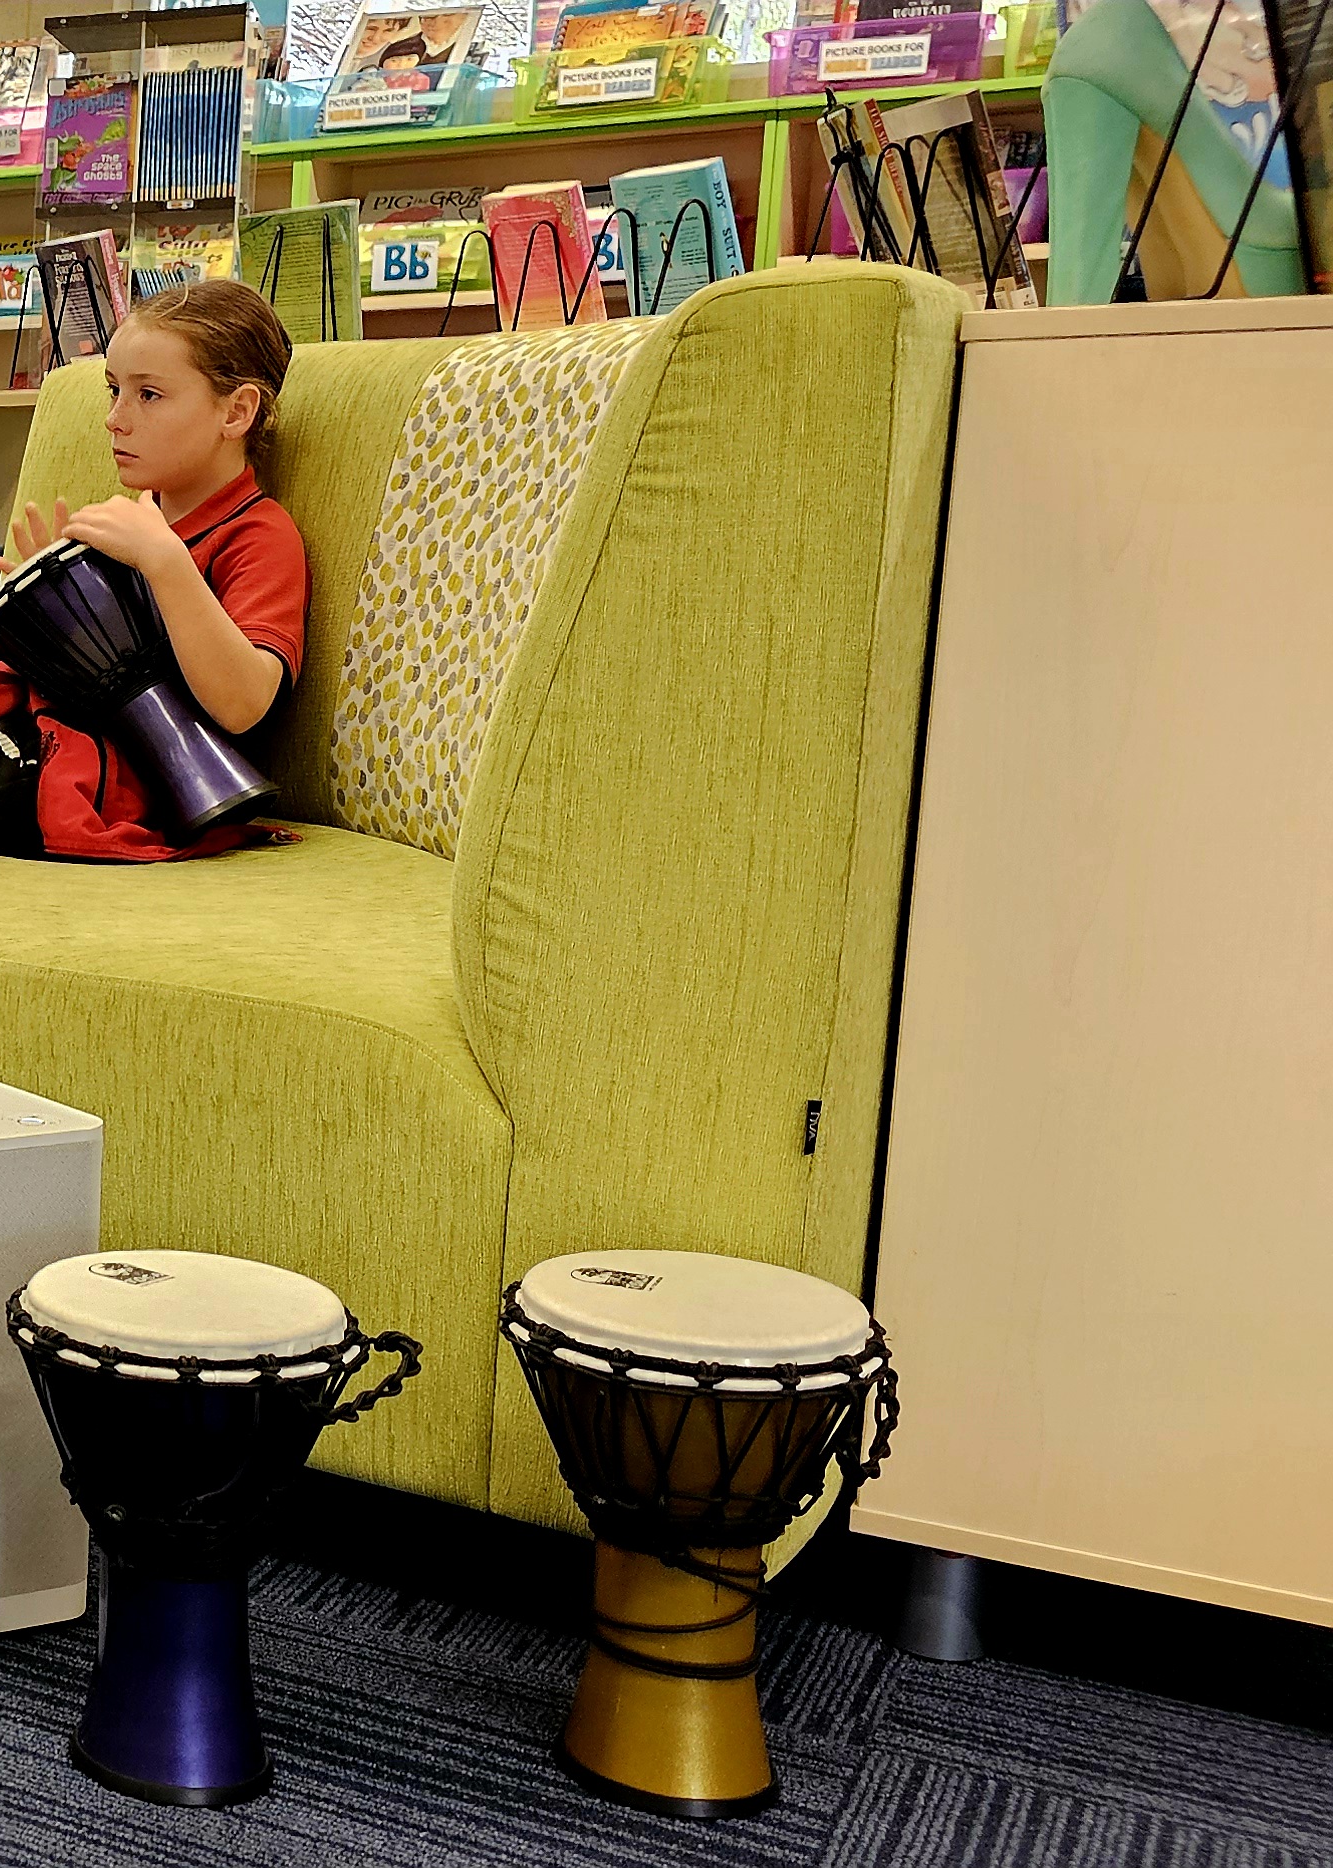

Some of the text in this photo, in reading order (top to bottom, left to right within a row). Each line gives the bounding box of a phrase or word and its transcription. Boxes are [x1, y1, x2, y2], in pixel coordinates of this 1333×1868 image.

[825, 42, 924, 57] PICTURE BOOKS FOR
[870, 55, 922, 70] READERS
[563, 67, 652, 83] PICTURE BOOKS FOR
[604, 79, 651, 94] READERS
[329, 93, 408, 107] PICTURE BOOKS FOR
[365, 104, 407, 118] READERS
[4, 128, 18, 137] FOR
[373, 195, 414, 210] PIG
[429, 187, 485, 208] GRUB
[714, 180, 737, 259] BOY SUIT
[384, 244, 429, 281] Bb
